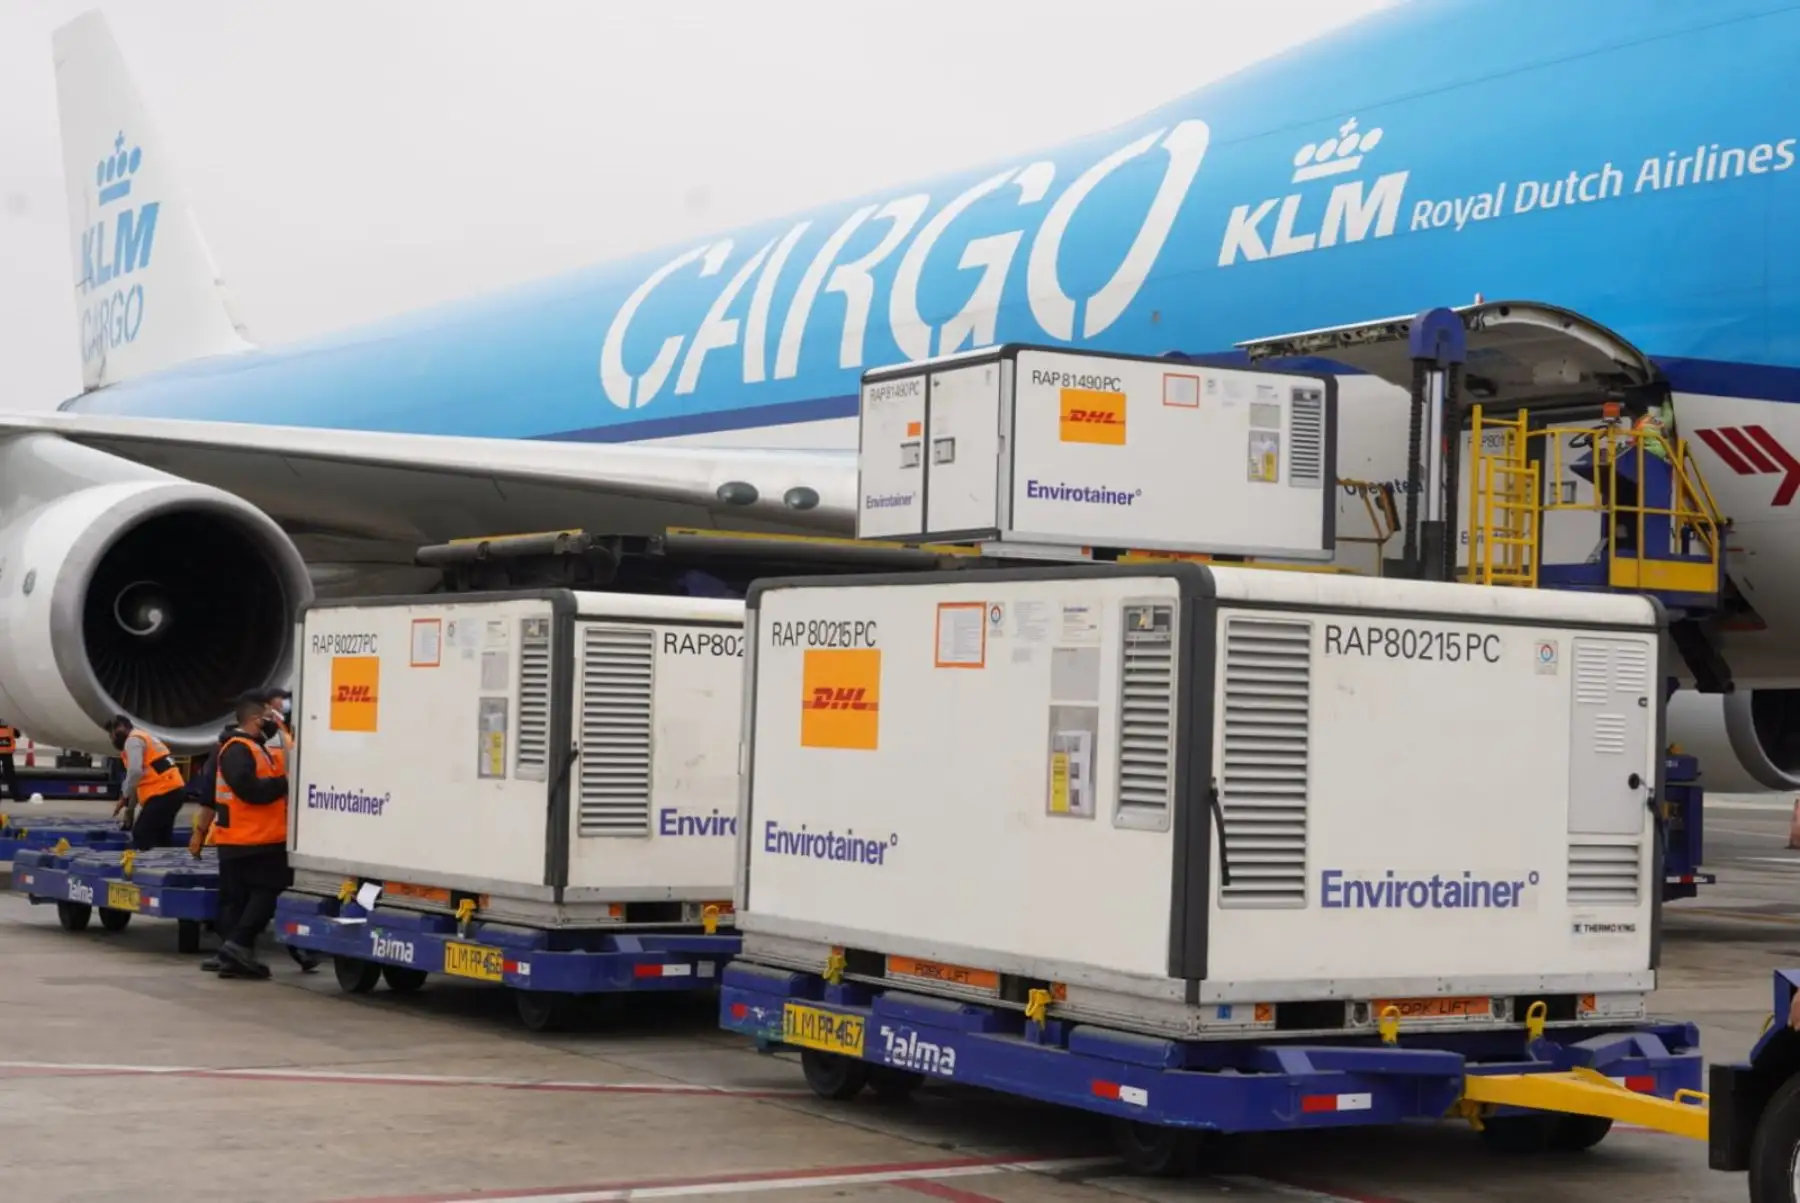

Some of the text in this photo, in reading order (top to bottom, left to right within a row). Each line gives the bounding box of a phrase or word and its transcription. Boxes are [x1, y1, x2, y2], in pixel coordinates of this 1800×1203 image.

[1217, 138, 1797, 267] KLM Royal Dutch Airlines
[80, 201, 160, 296] KLM
[601, 118, 1211, 411] CARGO
[81, 283, 144, 364] CARGO
[1070, 409, 1117, 424] DHL
[337, 685, 372, 703] DHL
[812, 686, 870, 710] DHL
[1439, 1000, 1472, 1015] LIFT
[879, 1025, 957, 1076] Talma
